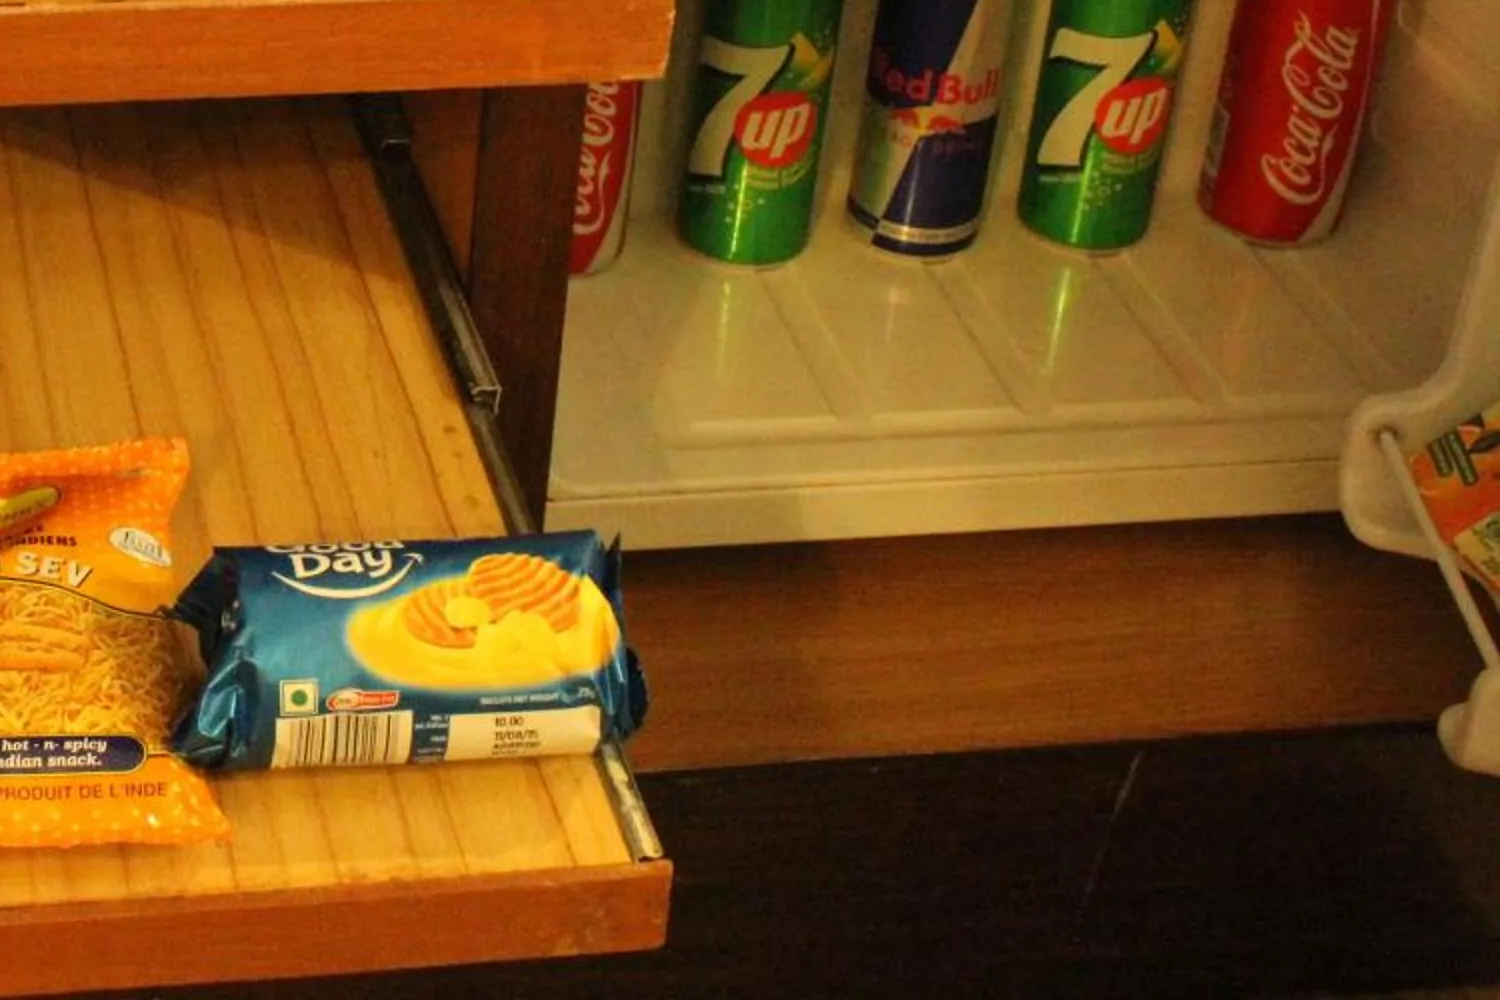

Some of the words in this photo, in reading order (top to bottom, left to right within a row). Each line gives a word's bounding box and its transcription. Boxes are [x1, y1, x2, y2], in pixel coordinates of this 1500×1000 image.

[936, 68, 999, 105] Bull
[17, 551, 95, 589] SEV
[289, 550, 394, 579] Day
[2, 739, 29, 752] hot
[64, 737, 108, 753] spicy
[47, 751, 102, 767] snack.
[79, 783, 103, 799] DE
